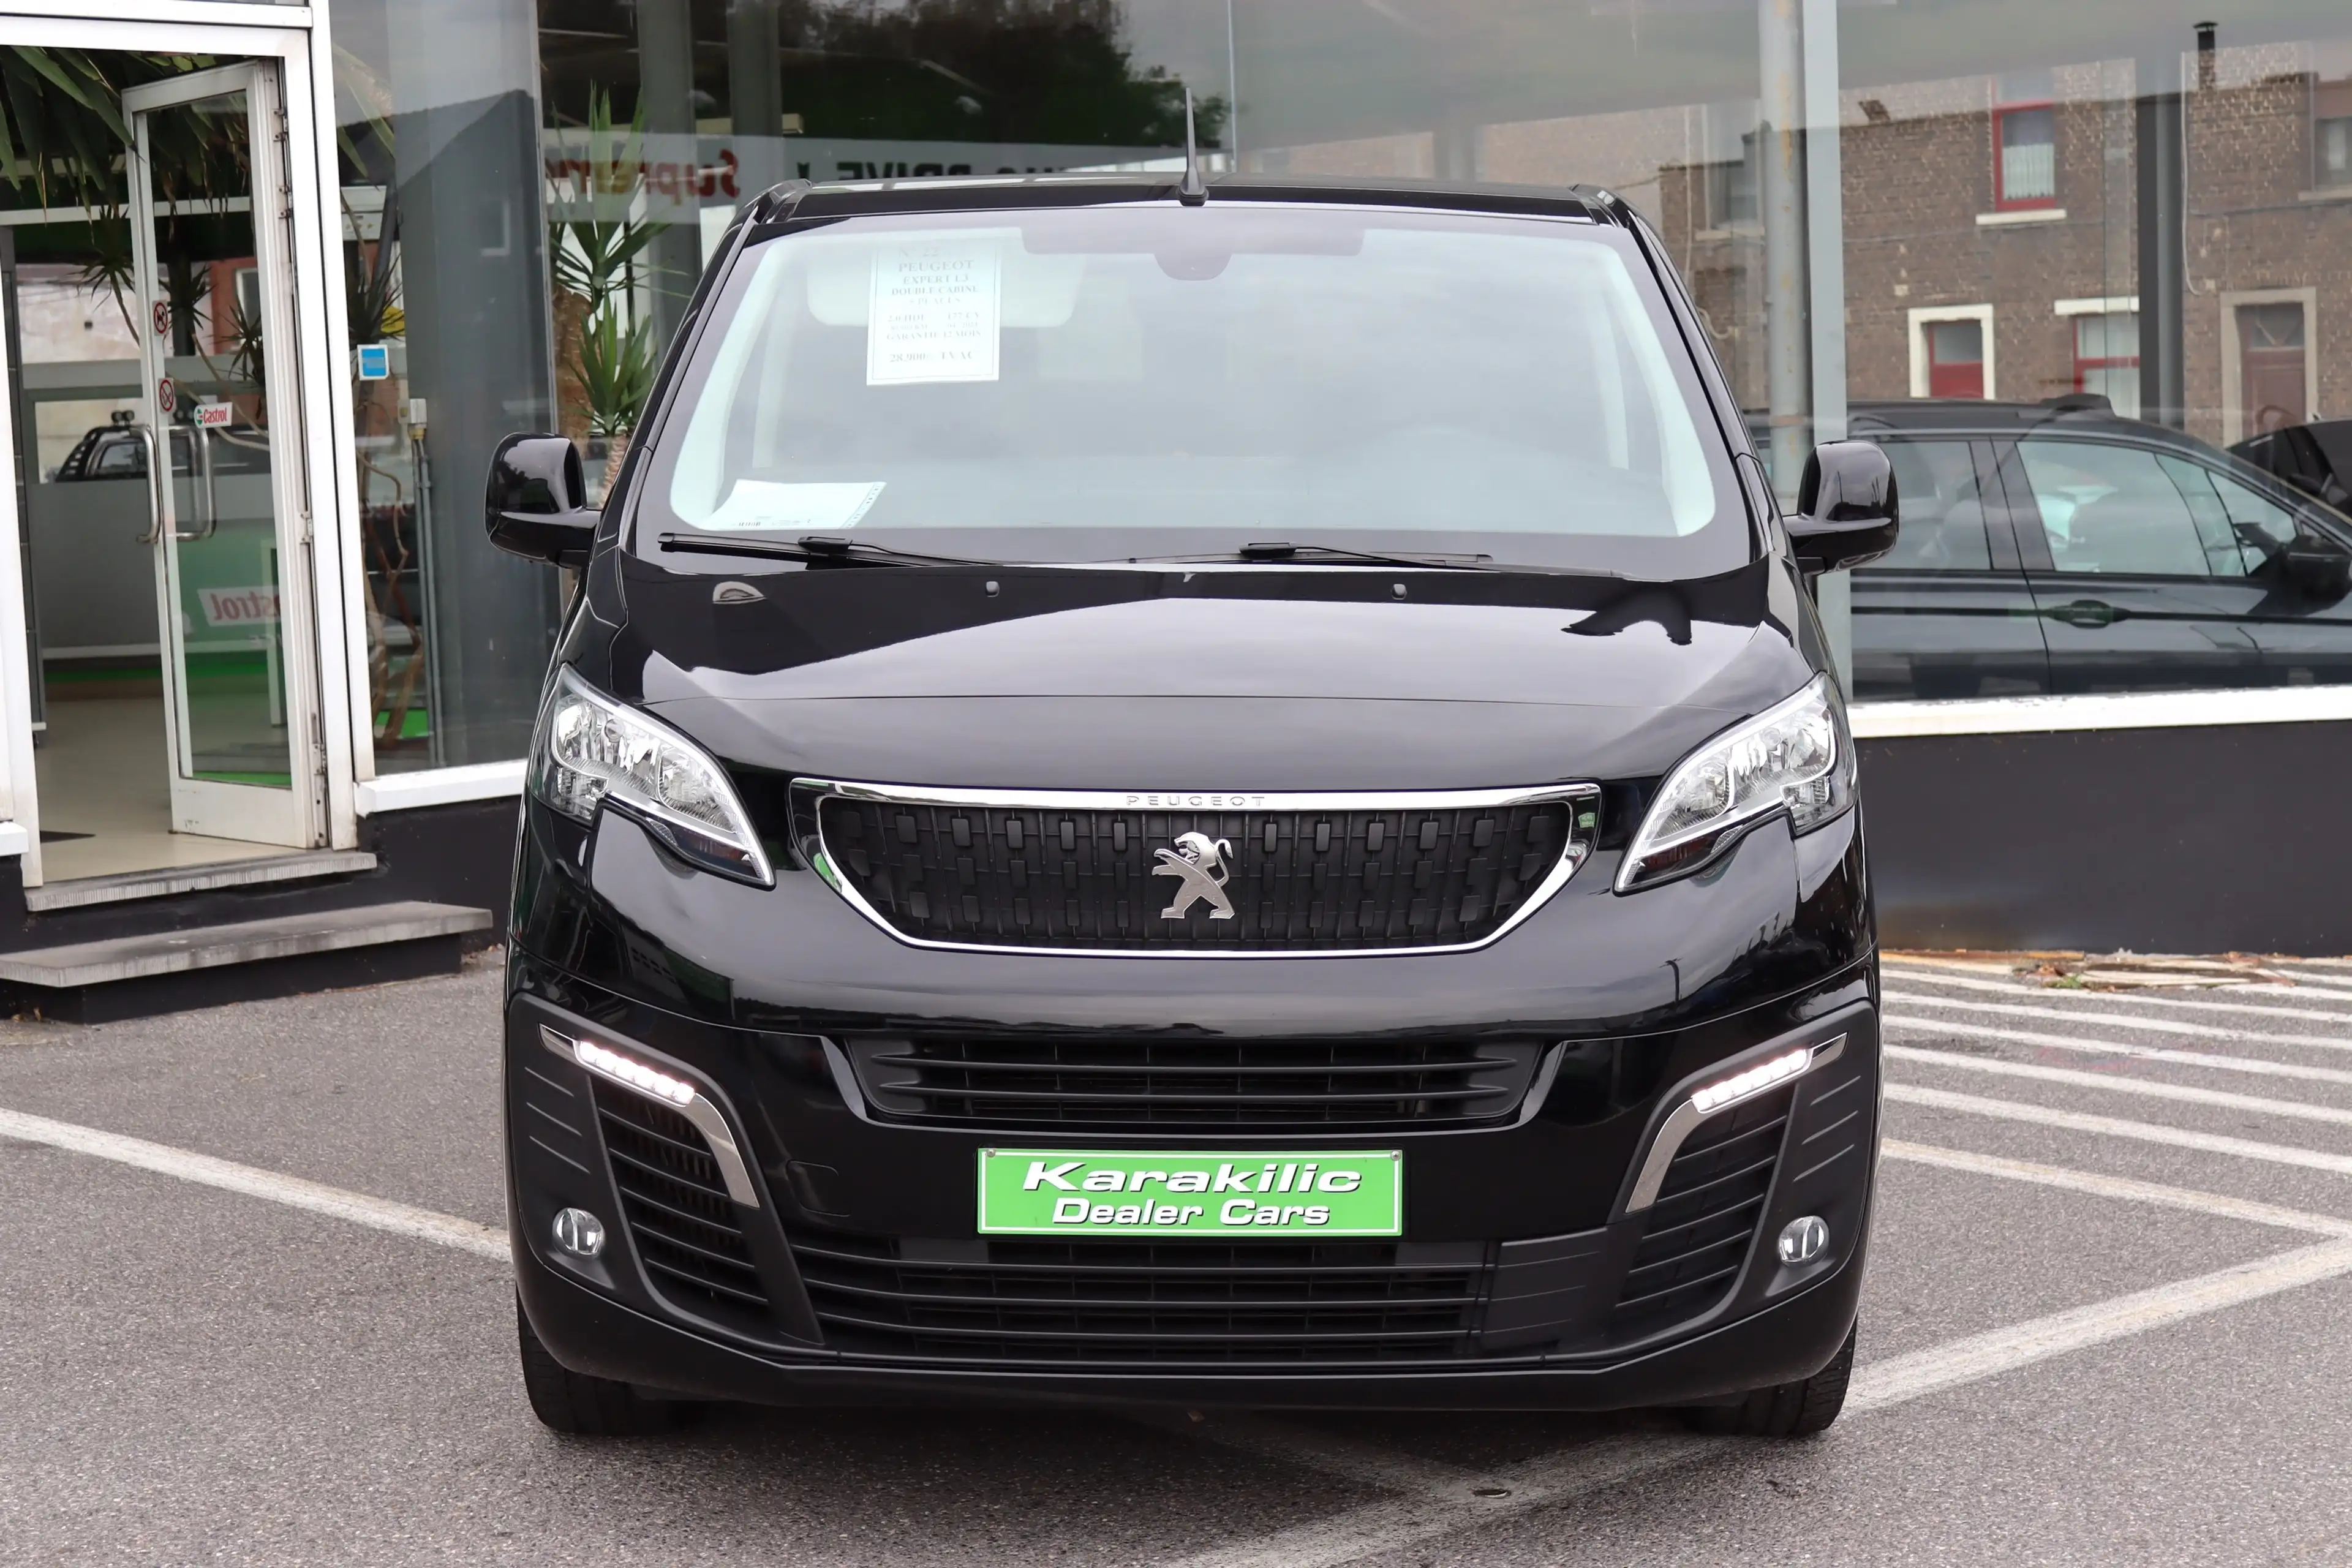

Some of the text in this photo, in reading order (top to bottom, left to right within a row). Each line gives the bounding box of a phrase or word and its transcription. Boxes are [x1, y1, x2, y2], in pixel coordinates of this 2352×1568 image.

[898, 260, 974, 272] PEUGEOT
[903, 273, 969, 284] EXPERT L3
[891, 285, 979, 295] DOUBLE CABINE
[203, 407, 228, 424] Castrol
[1126, 796, 1265, 807] PEUGEOT
[1022, 1161, 1363, 1193] Karakilic
[1052, 1197, 1330, 1226] Dealer Cars
